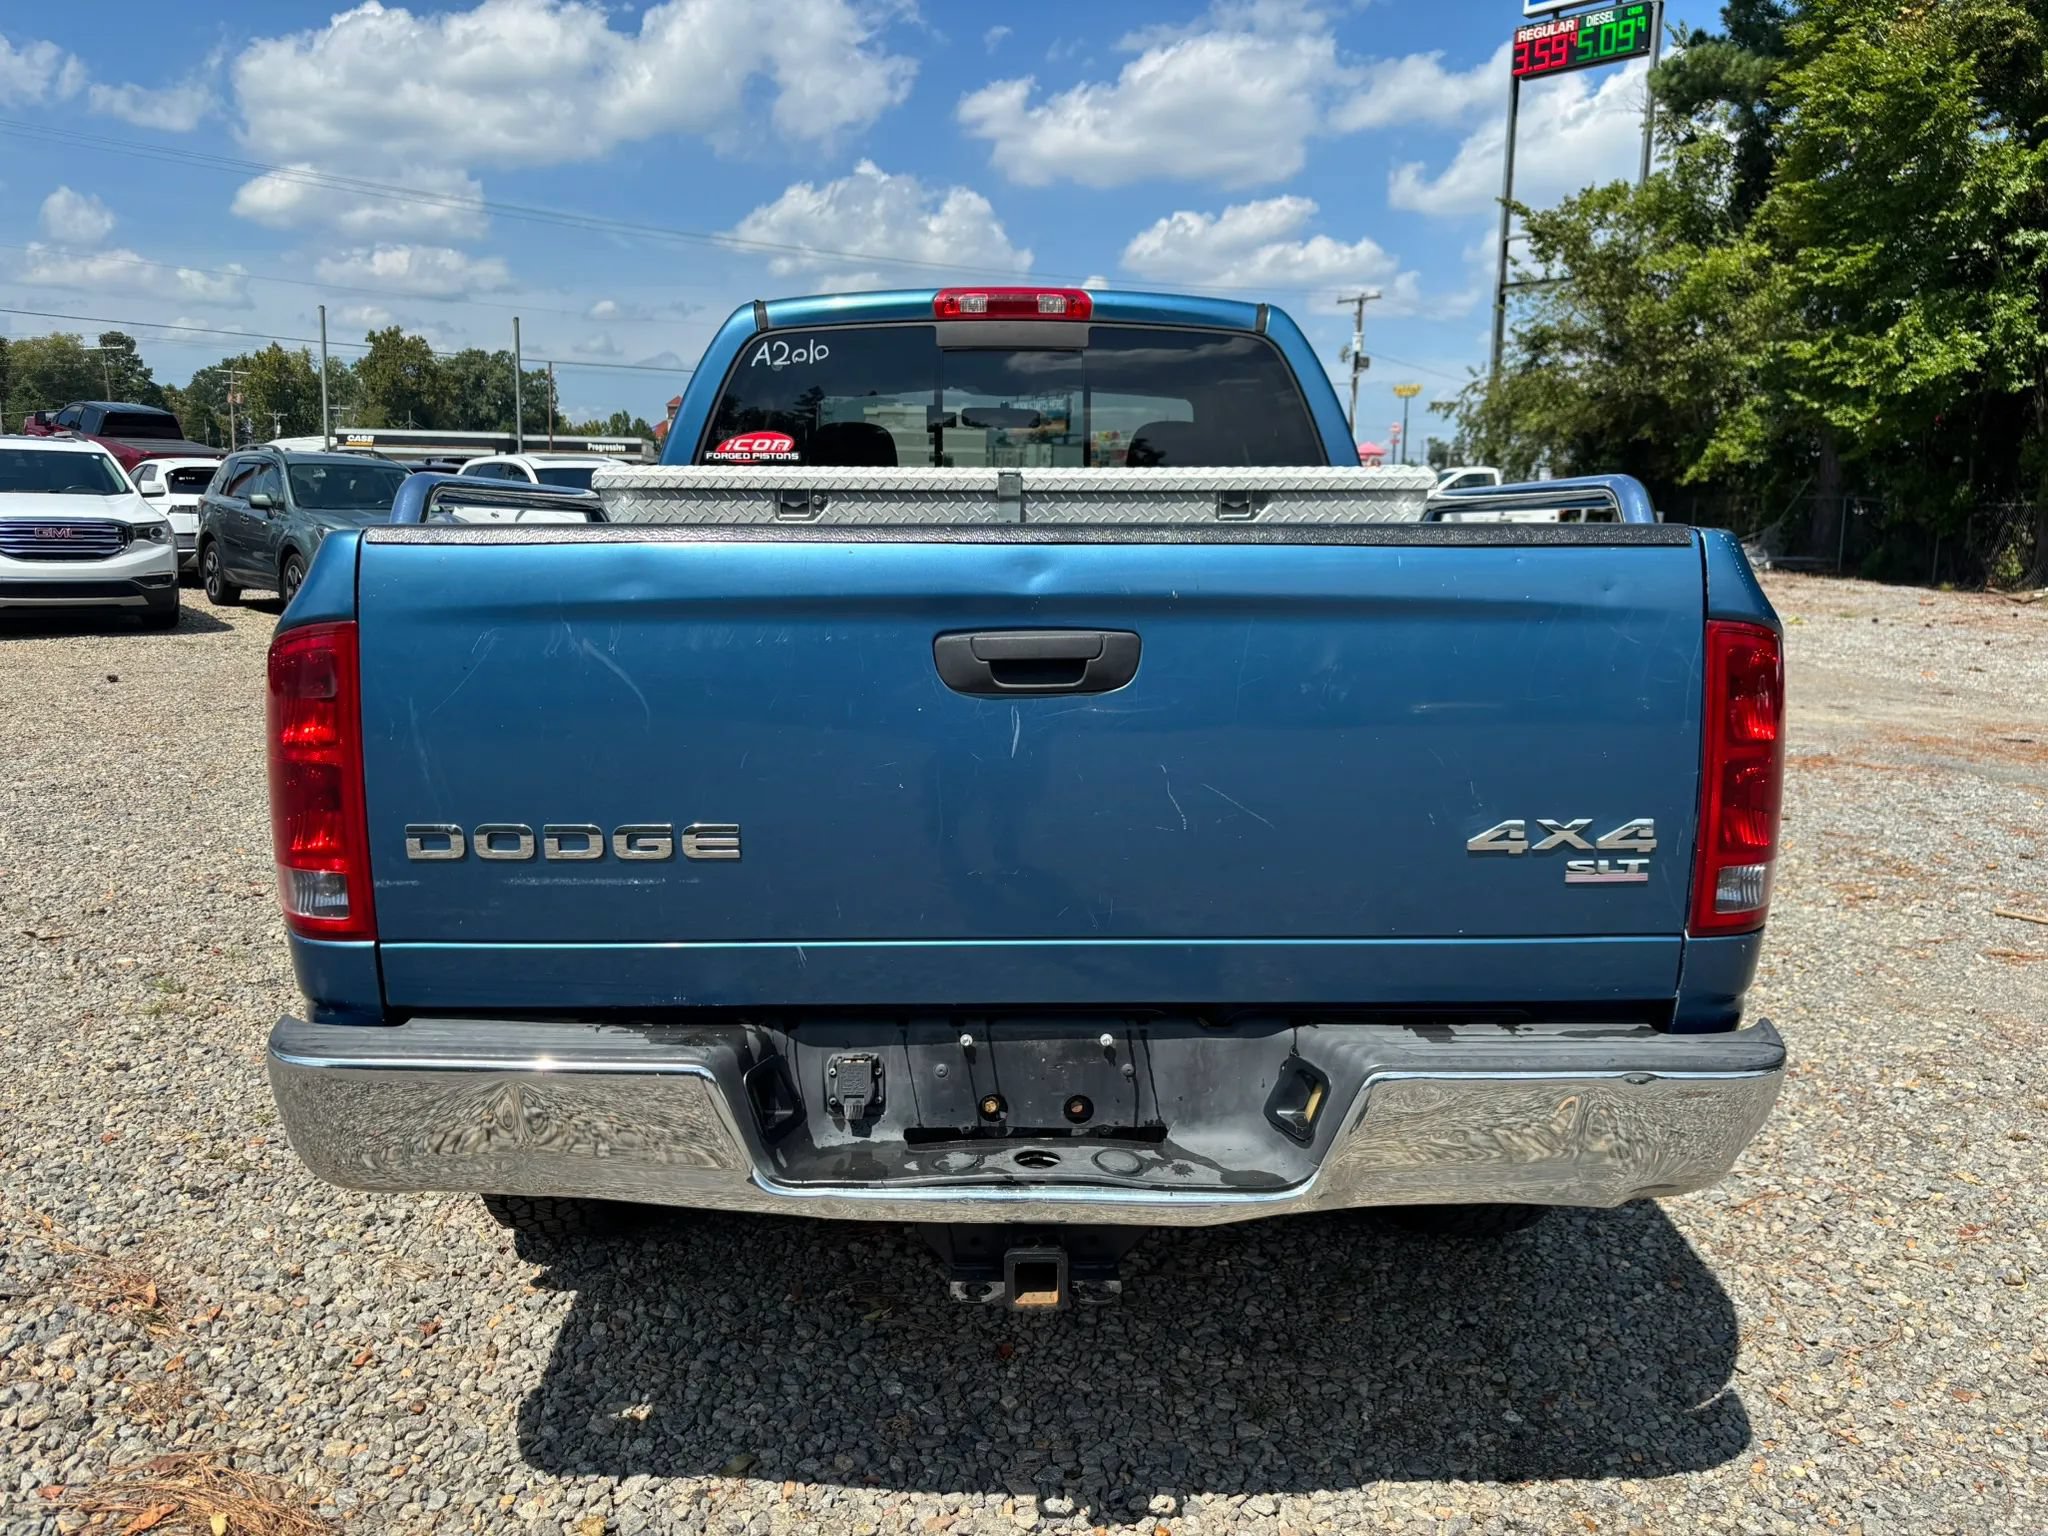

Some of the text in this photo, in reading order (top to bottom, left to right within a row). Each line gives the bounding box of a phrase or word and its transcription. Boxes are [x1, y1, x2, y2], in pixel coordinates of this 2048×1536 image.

[1586, 10, 1616, 27] DIESEL
[1518, 19, 1575, 43] REGULAR
[347, 434, 375, 443] CASE
[587, 442, 626, 453] Progressive
[706, 452, 799, 460] FORGED PISTONS
[34, 527, 84, 539] GMC
[404, 823, 742, 860] DODGE
[1466, 818, 1657, 855] 4X4
[1565, 859, 1650, 875] SLT
